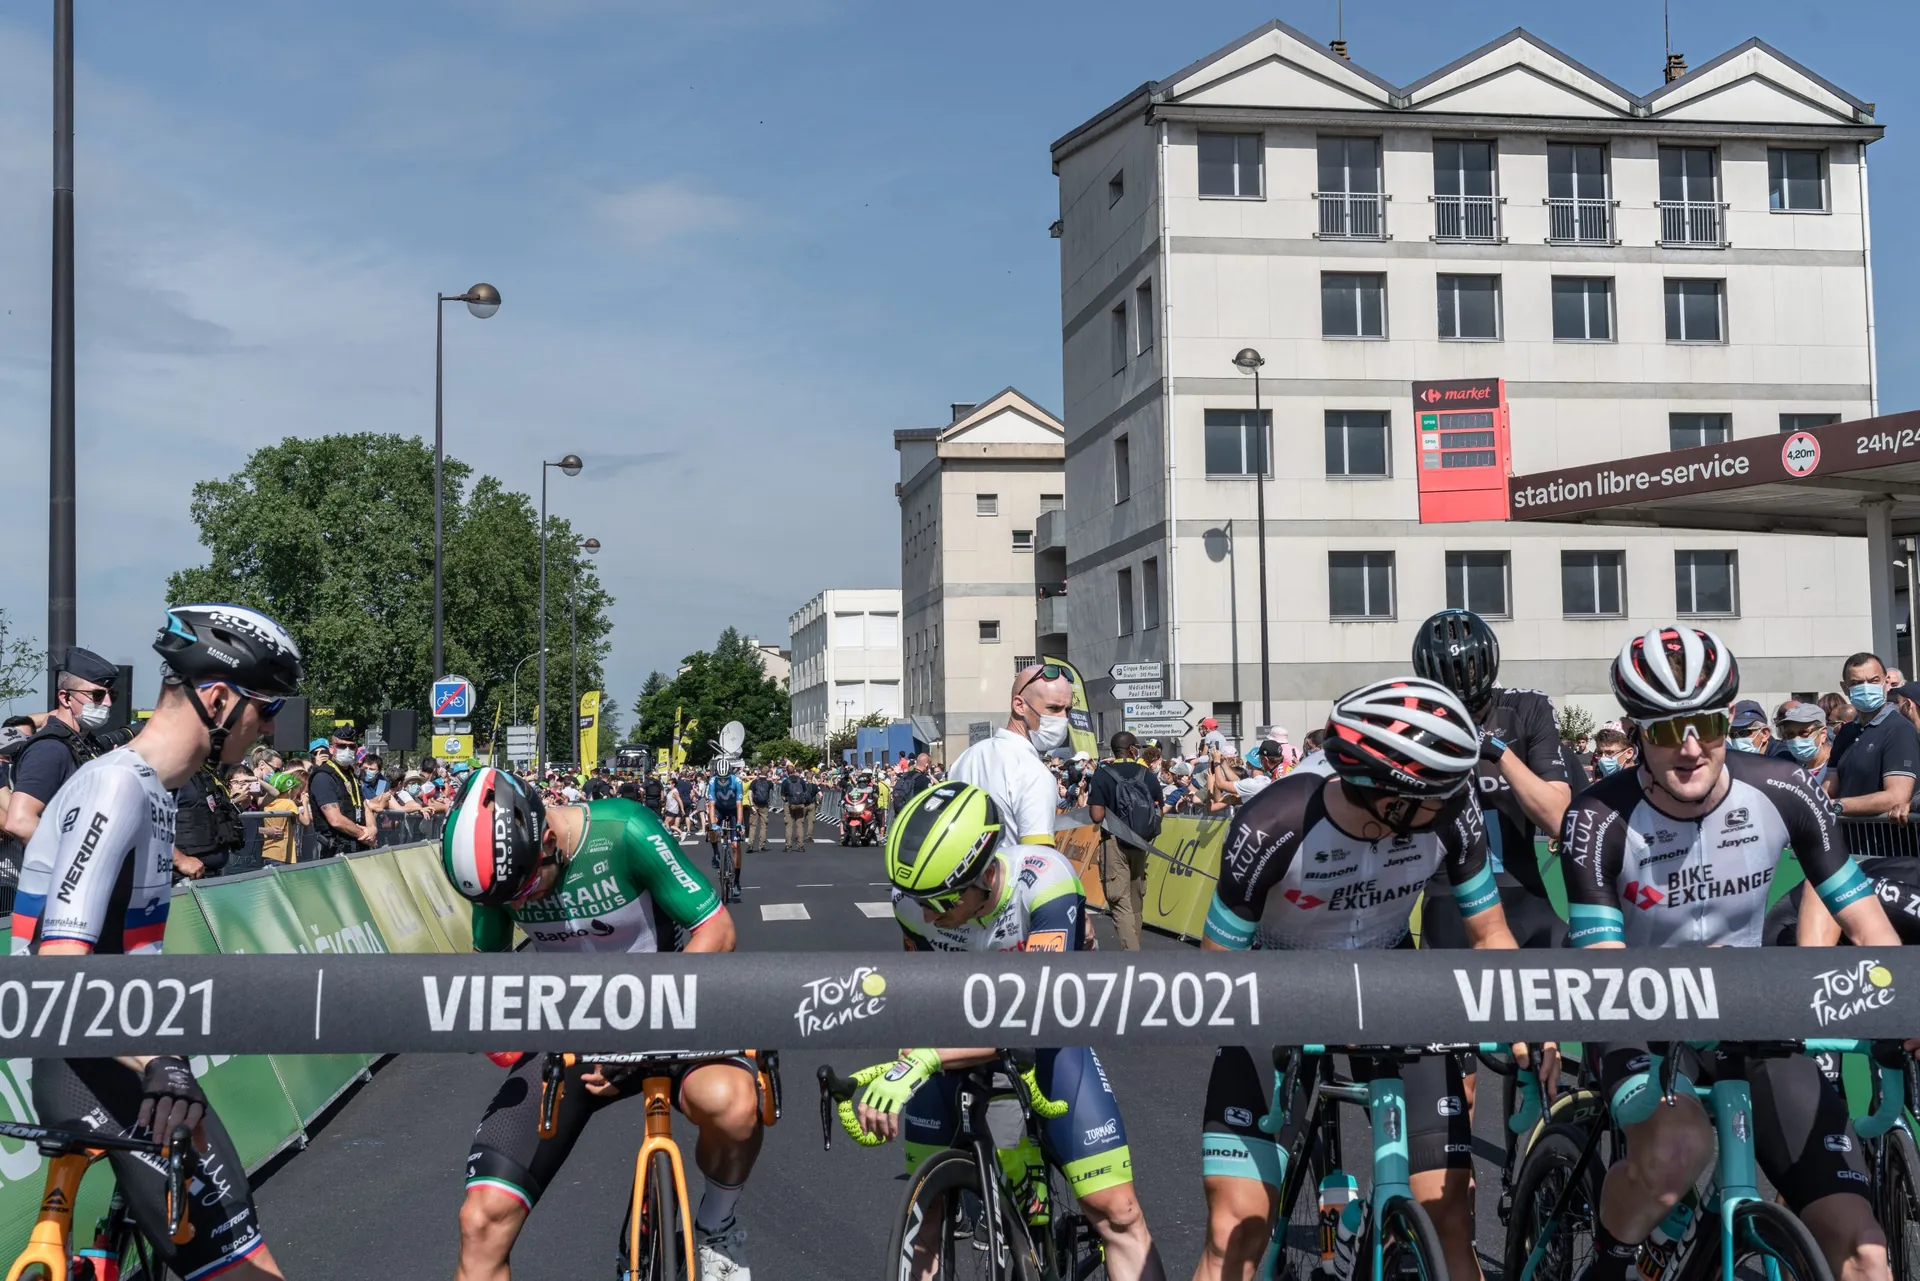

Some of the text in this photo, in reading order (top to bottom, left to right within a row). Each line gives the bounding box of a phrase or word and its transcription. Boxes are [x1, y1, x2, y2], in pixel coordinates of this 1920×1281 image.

[1445, 386, 1492, 401] market
[1787, 449, 1815, 460] 4,20m
[1514, 453, 1750, 509] station libre-service
[209, 612, 288, 654] RUDY
[215, 621, 282, 656] PROJECT
[1766, 778, 1831, 853] experiencealula.com
[1792, 768, 1837, 827] ALULA
[495, 803, 508, 882] RUDY
[1232, 829, 1271, 884] ALULA
[1573, 809, 1599, 868] ALULA
[1639, 847, 1690, 867] Bianchi
[1717, 835, 1759, 849] Jayco
[57, 811, 109, 905] MERIDA
[647, 834, 702, 894] MERIDA
[1169, 838, 1201, 878] LCL
[1244, 830, 1295, 902] experiencealula.com
[1304, 865, 1358, 880] Bianchi
[1383, 854, 1422, 868] Jayco
[518, 875, 621, 910] AHRAIN
[1332, 879, 1377, 900] BIKE
[1667, 867, 1774, 909] EXCHANGE
[1668, 864, 1714, 891] BIKE
[515, 893, 627, 922] VICTORIOUS
[534, 929, 589, 943] Bapco
[802, 966, 876, 1009] Tour
[851, 990, 864, 1003] de
[1453, 967, 1720, 1022] VIERZON
[1812, 960, 1880, 1000] Tour
[1862, 982, 1874, 994] de
[0, 972, 214, 1046] 07/2021
[422, 974, 698, 1032] VIERZON
[963, 966, 1260, 1036] 02/07/2021
[582, 1053, 642, 1063] vision
[961, 1092, 971, 1133] CUBE
[1086, 1122, 1117, 1140] TORMANS
[1202, 1148, 1249, 1158] ianchi
[1070, 1165, 1112, 1184] CUBE
[211, 1208, 249, 1238] MERIDA
